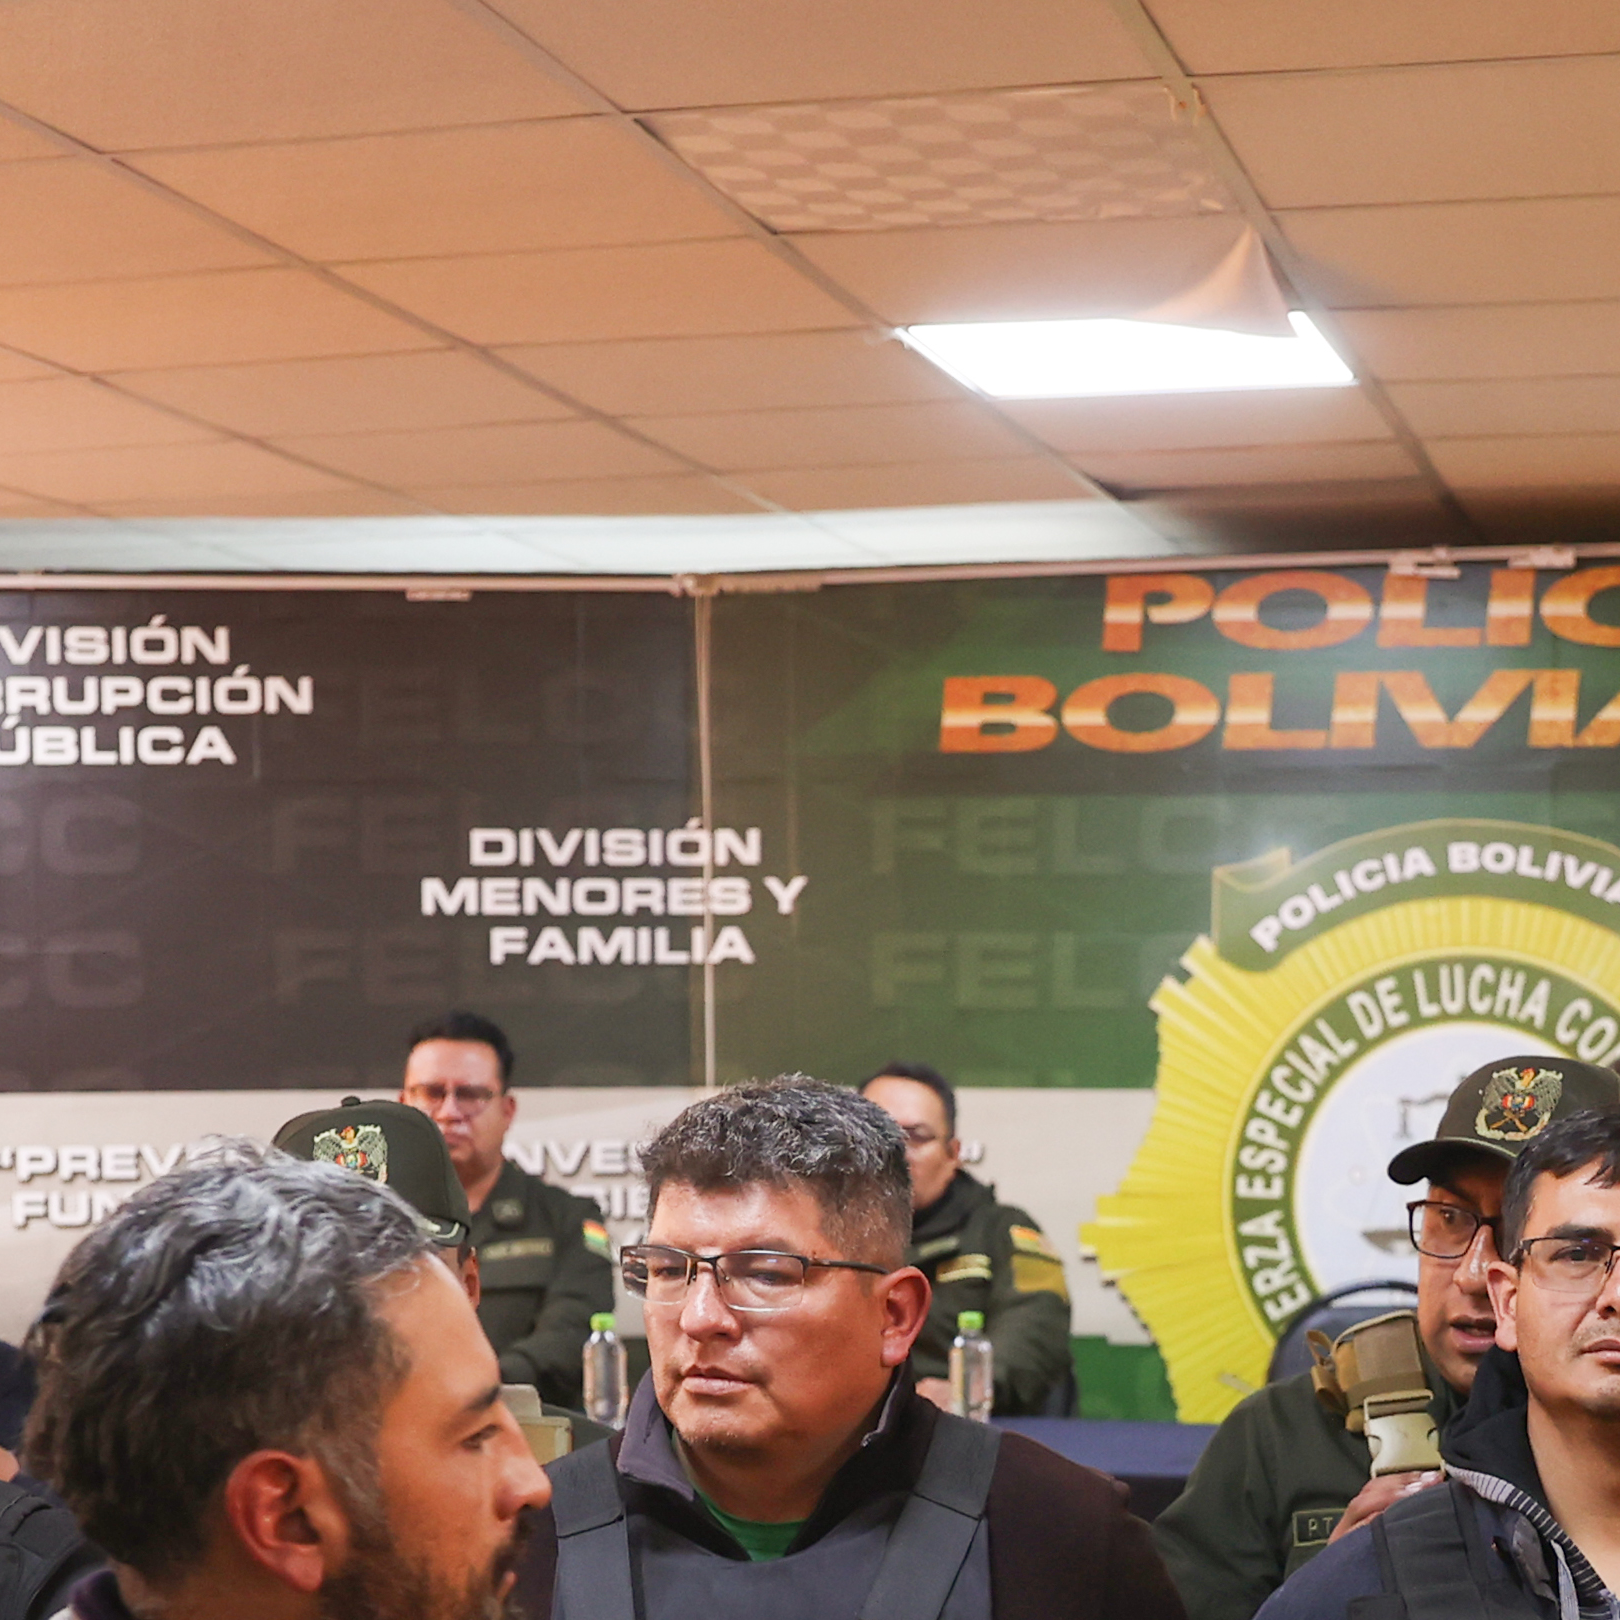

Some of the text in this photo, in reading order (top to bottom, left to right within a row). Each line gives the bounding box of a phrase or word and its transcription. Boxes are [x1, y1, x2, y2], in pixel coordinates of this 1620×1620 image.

[468, 817, 761, 867] DIVISIÓN
[421, 876, 808, 917] MENORES Y
[1249, 846, 1437, 954] POLICIA
[490, 926, 755, 965] FAMILIA
[1347, 975, 1411, 1039] DE
[1414, 962, 1552, 1029] LUCHA
[1236, 1018, 1357, 1200] ESPECIAL
[1237, 1209, 1312, 1324] ERZA
